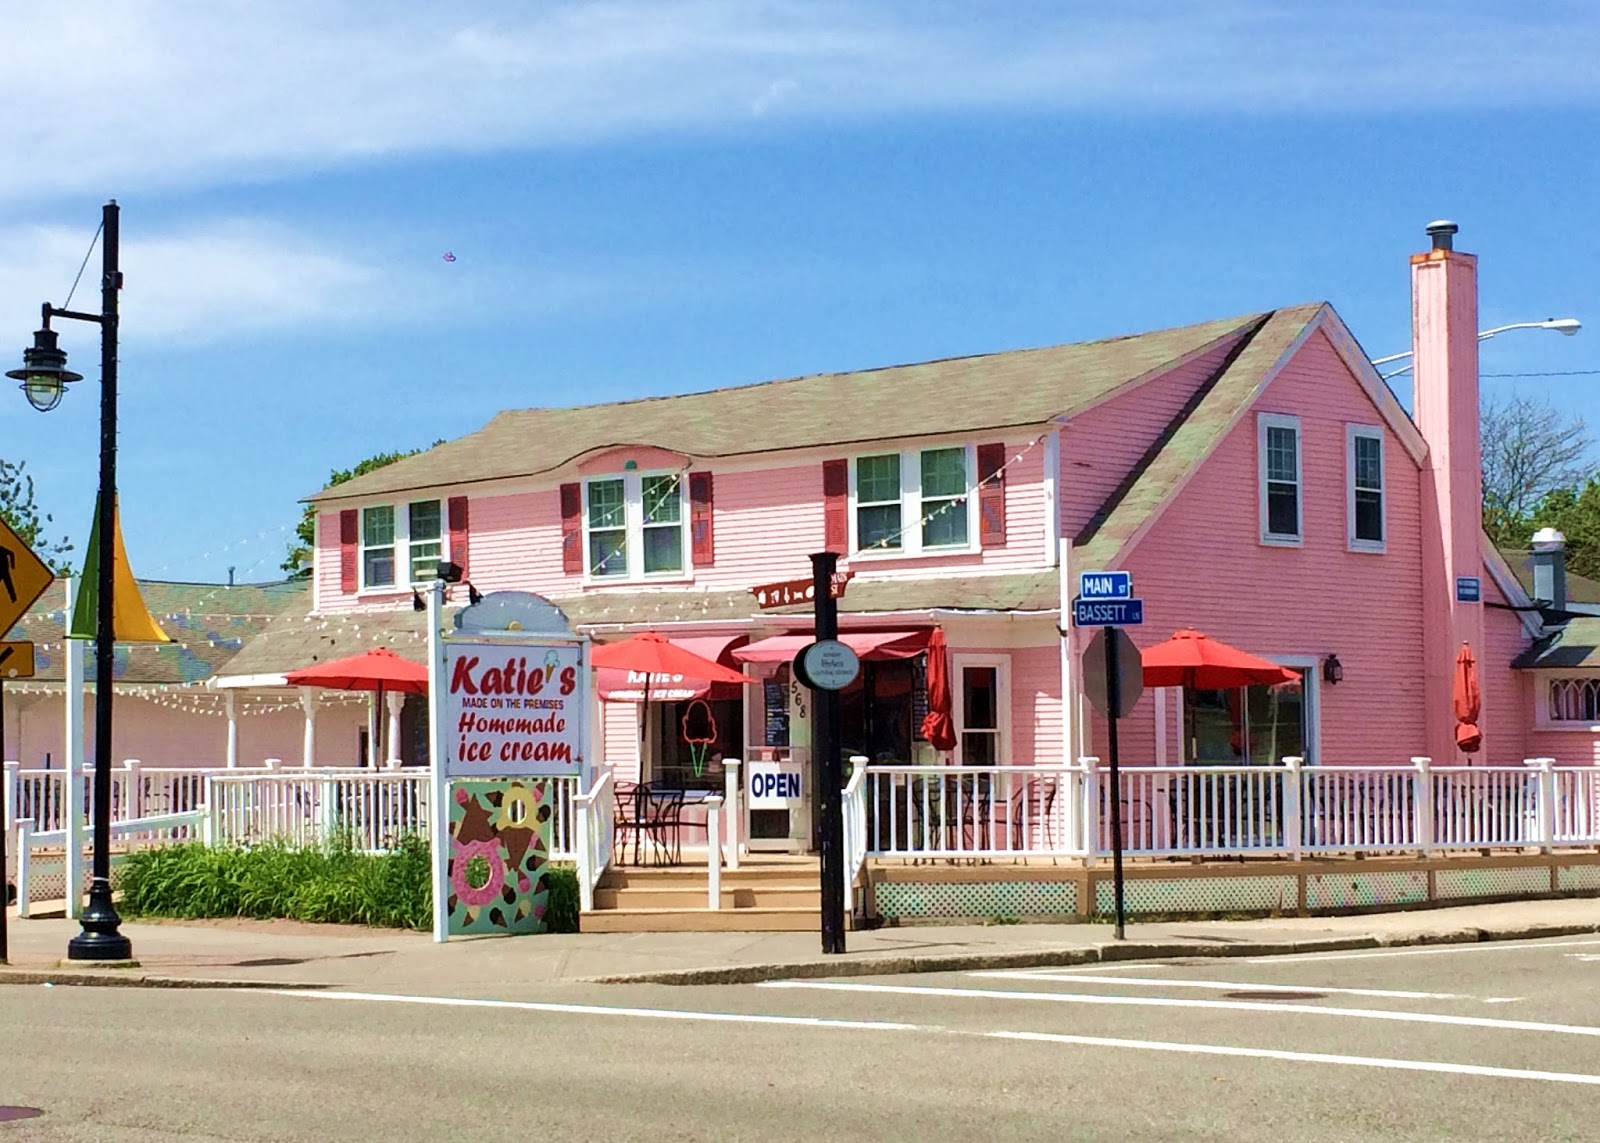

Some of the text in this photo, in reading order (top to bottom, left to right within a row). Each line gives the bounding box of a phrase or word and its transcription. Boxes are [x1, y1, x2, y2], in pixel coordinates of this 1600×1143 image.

[1084, 577, 1127, 594] MAIN ST
[1079, 604, 1127, 621] BASSETT
[450, 655, 576, 695] Katie's
[627, 669, 684, 683] KATIES
[462, 698, 564, 710] MADE ON THE PREMISES
[458, 711, 566, 735] Homemade
[459, 734, 571, 764] ice cream
[751, 773, 800, 798] OPEN
